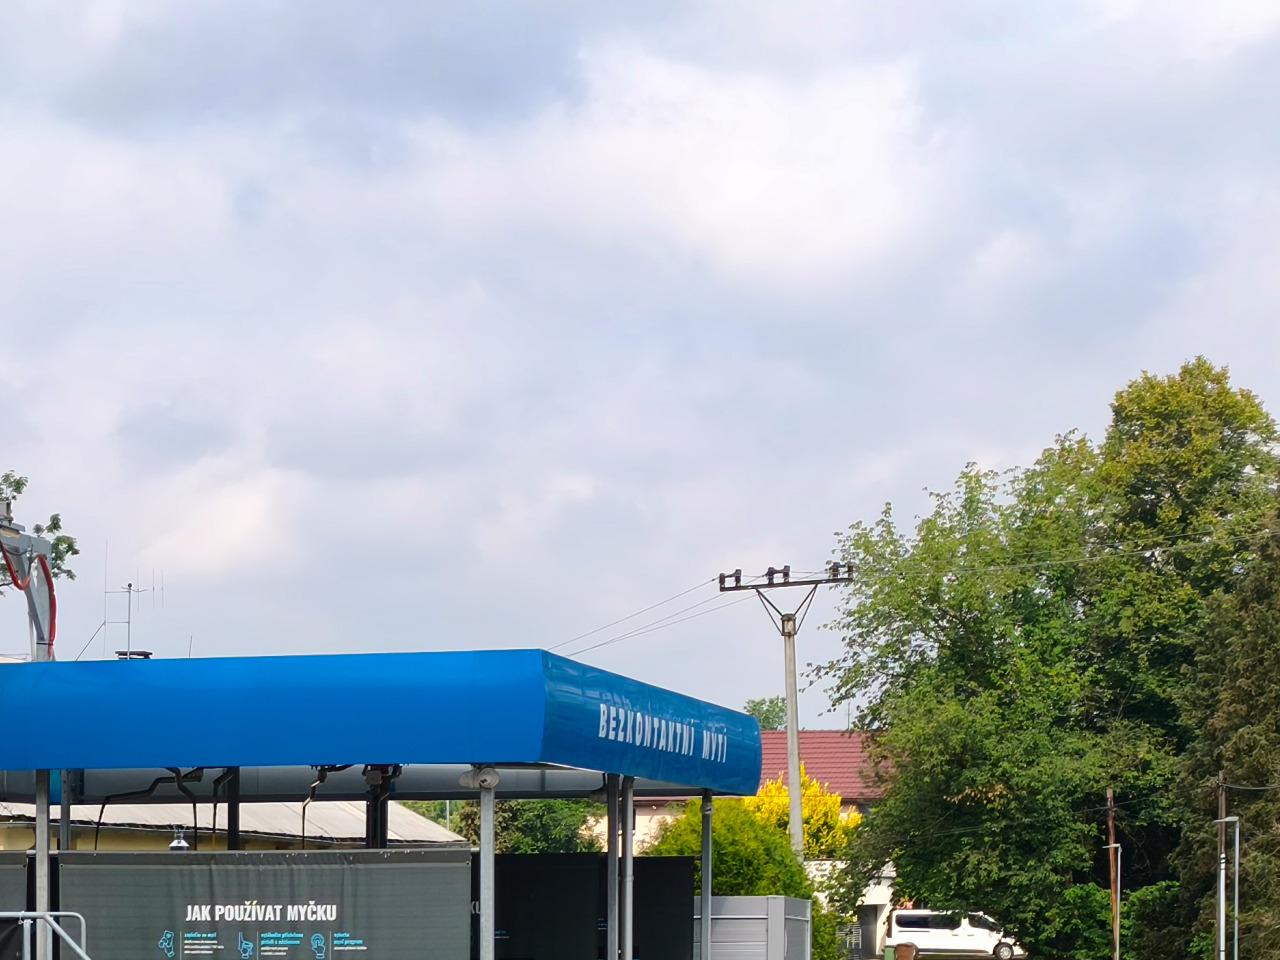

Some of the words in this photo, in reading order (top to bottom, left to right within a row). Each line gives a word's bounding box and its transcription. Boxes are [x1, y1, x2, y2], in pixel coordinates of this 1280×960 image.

[599, 704, 695, 757] BEZKONTAKTNÍ
[702, 727, 728, 763] MYTÍ
[185, 904, 212, 922] JAK
[215, 900, 284, 922] POUŽÍVAT
[287, 900, 337, 922] MYČKU
